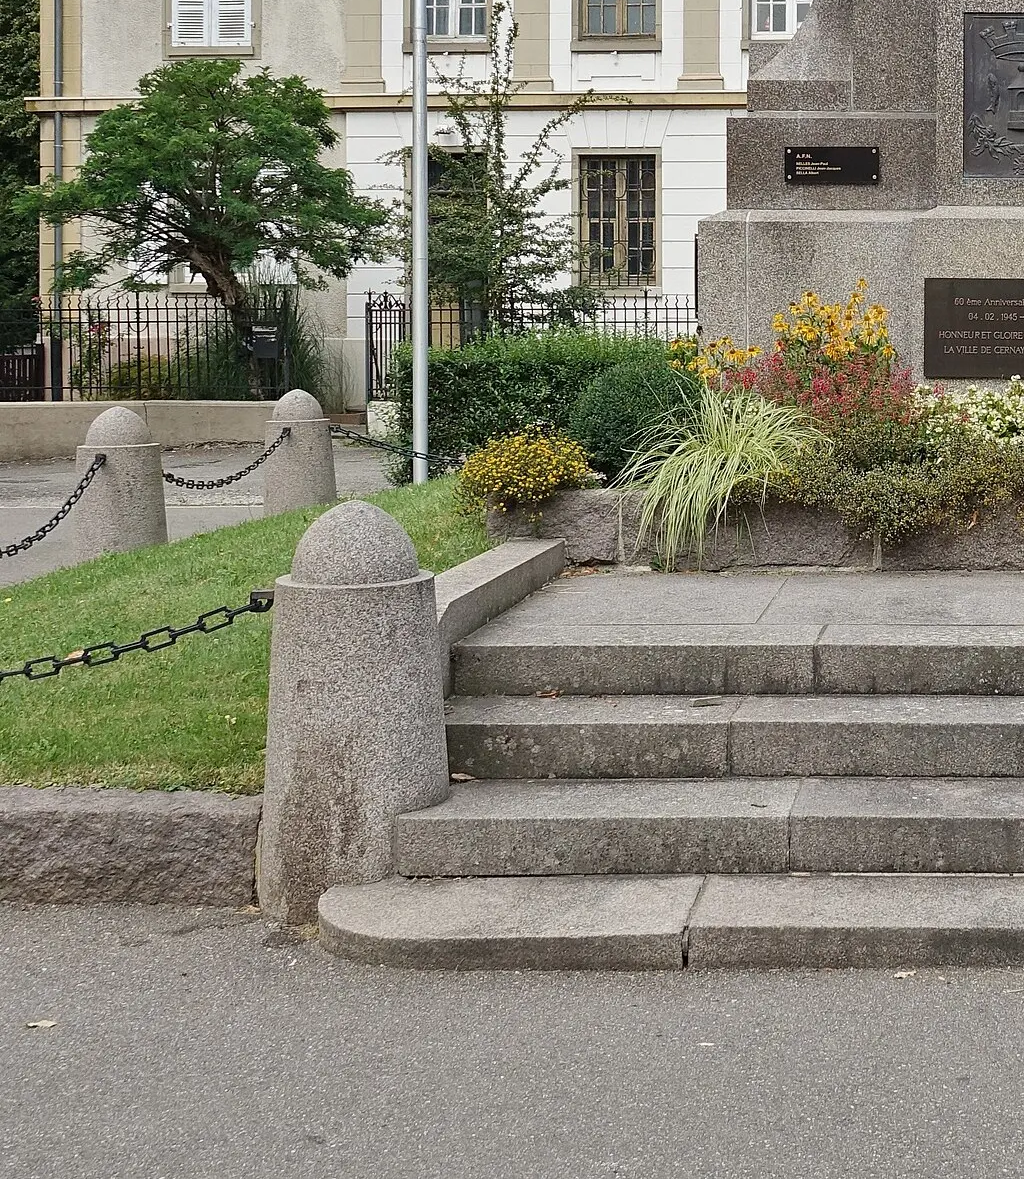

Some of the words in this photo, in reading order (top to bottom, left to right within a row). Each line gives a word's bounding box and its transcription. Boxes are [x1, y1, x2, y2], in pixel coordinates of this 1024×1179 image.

[954, 297, 964, 306] 60
[966, 297, 982, 306] ème
[938, 330, 980, 340] HONNEUR
[981, 331, 992, 340] ET
[993, 331, 1023, 340] GLOIRE
[943, 346, 955, 354] LA
[956, 346, 978, 355] VILLE
[980, 346, 992, 355] DE
